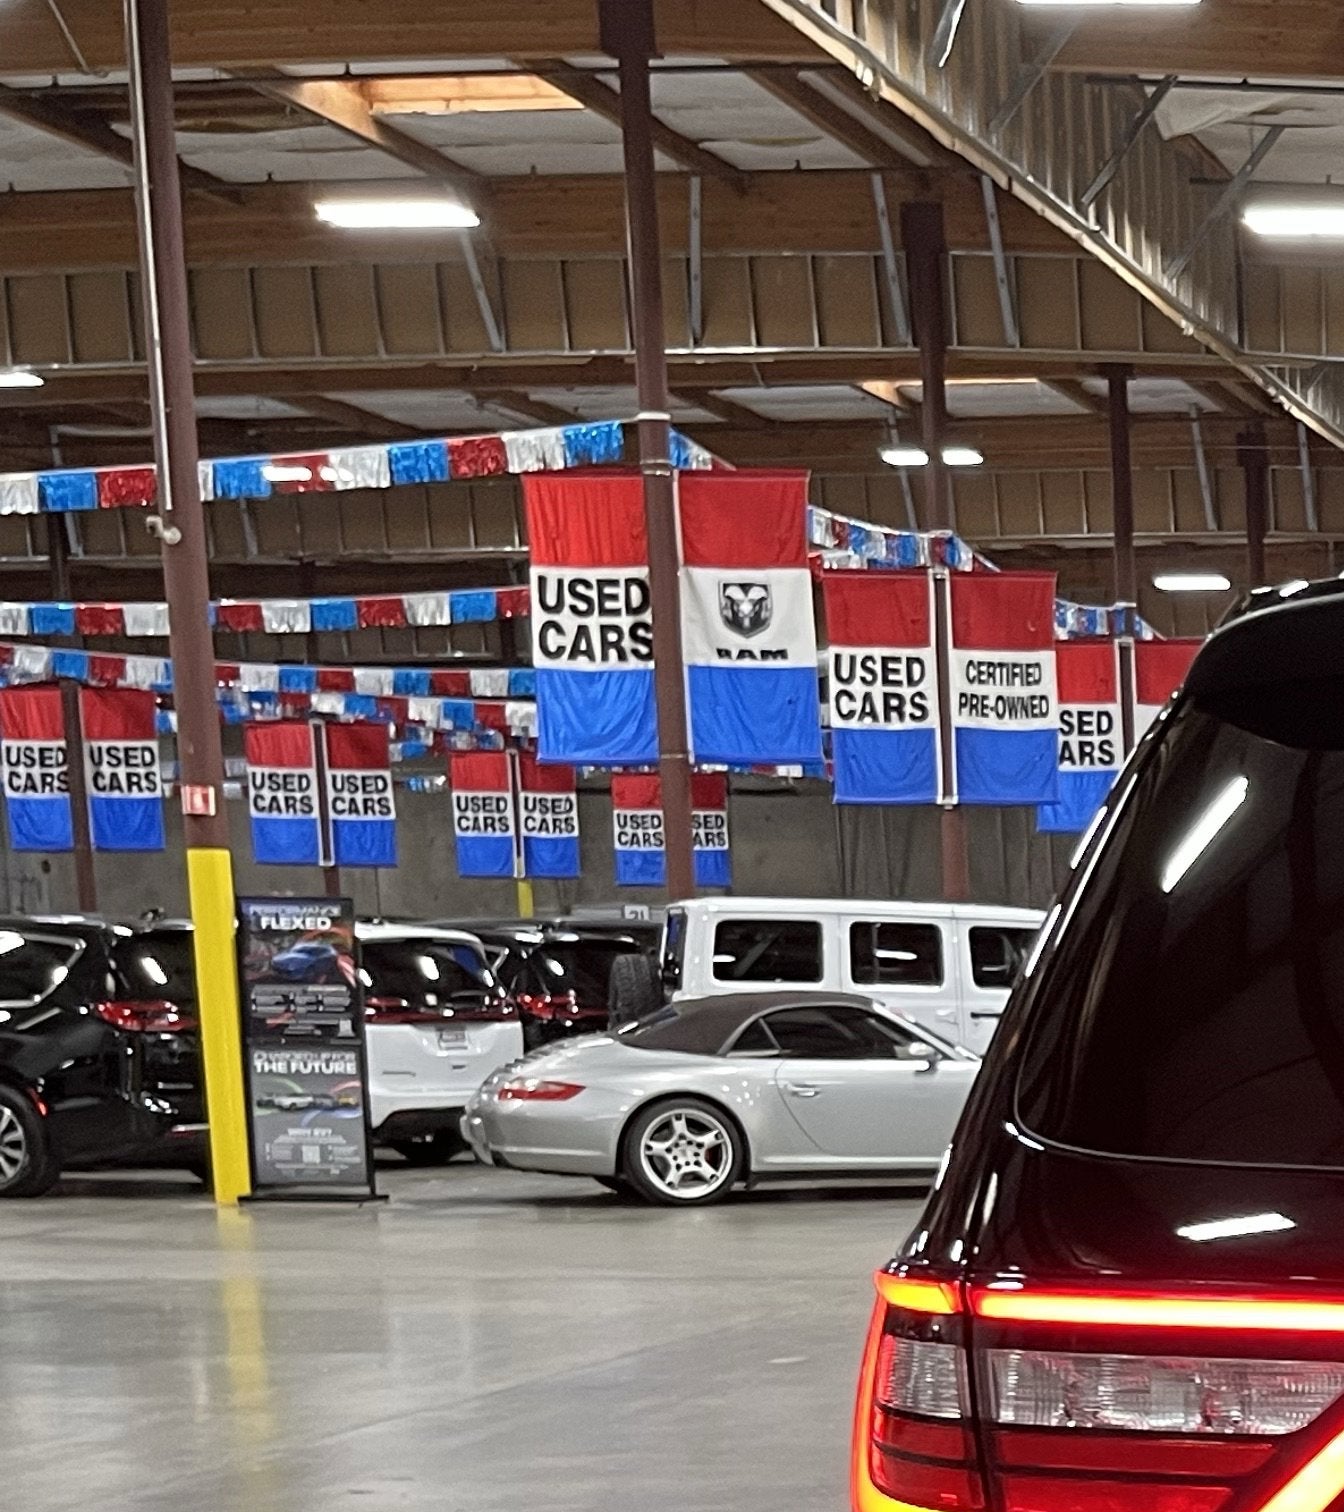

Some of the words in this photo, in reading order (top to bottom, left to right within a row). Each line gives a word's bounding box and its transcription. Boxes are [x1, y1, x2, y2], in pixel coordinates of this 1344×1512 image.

[537, 576, 651, 618] USED
[538, 620, 653, 663] CARS
[716, 648, 788, 660] RAM
[834, 654, 926, 688] USED
[966, 660, 1041, 687] CERTIFIED
[835, 690, 929, 723] CARS
[959, 693, 1049, 720] PRE-OWNED
[1059, 710, 1113, 737] SED
[5, 746, 67, 768] USED
[89, 746, 155, 768] USED
[1059, 740, 1115, 766] ARS
[8, 771, 70, 793] CARS
[92, 771, 157, 793] CARS
[252, 772, 311, 792] USED
[331, 774, 388, 794] USED
[253, 794, 314, 814] CARS
[331, 797, 391, 816] CARS
[456, 796, 508, 813] USED
[524, 796, 573, 815] USED
[457, 816, 510, 833] CARS
[524, 816, 575, 833] CARS
[617, 813, 661, 830] USED
[692, 814, 724, 830] SED
[618, 831, 664, 847] CARS
[693, 832, 726, 847] ARS
[261, 916, 331, 930] FLEXED
[291, 1061, 356, 1074] FUTURE
